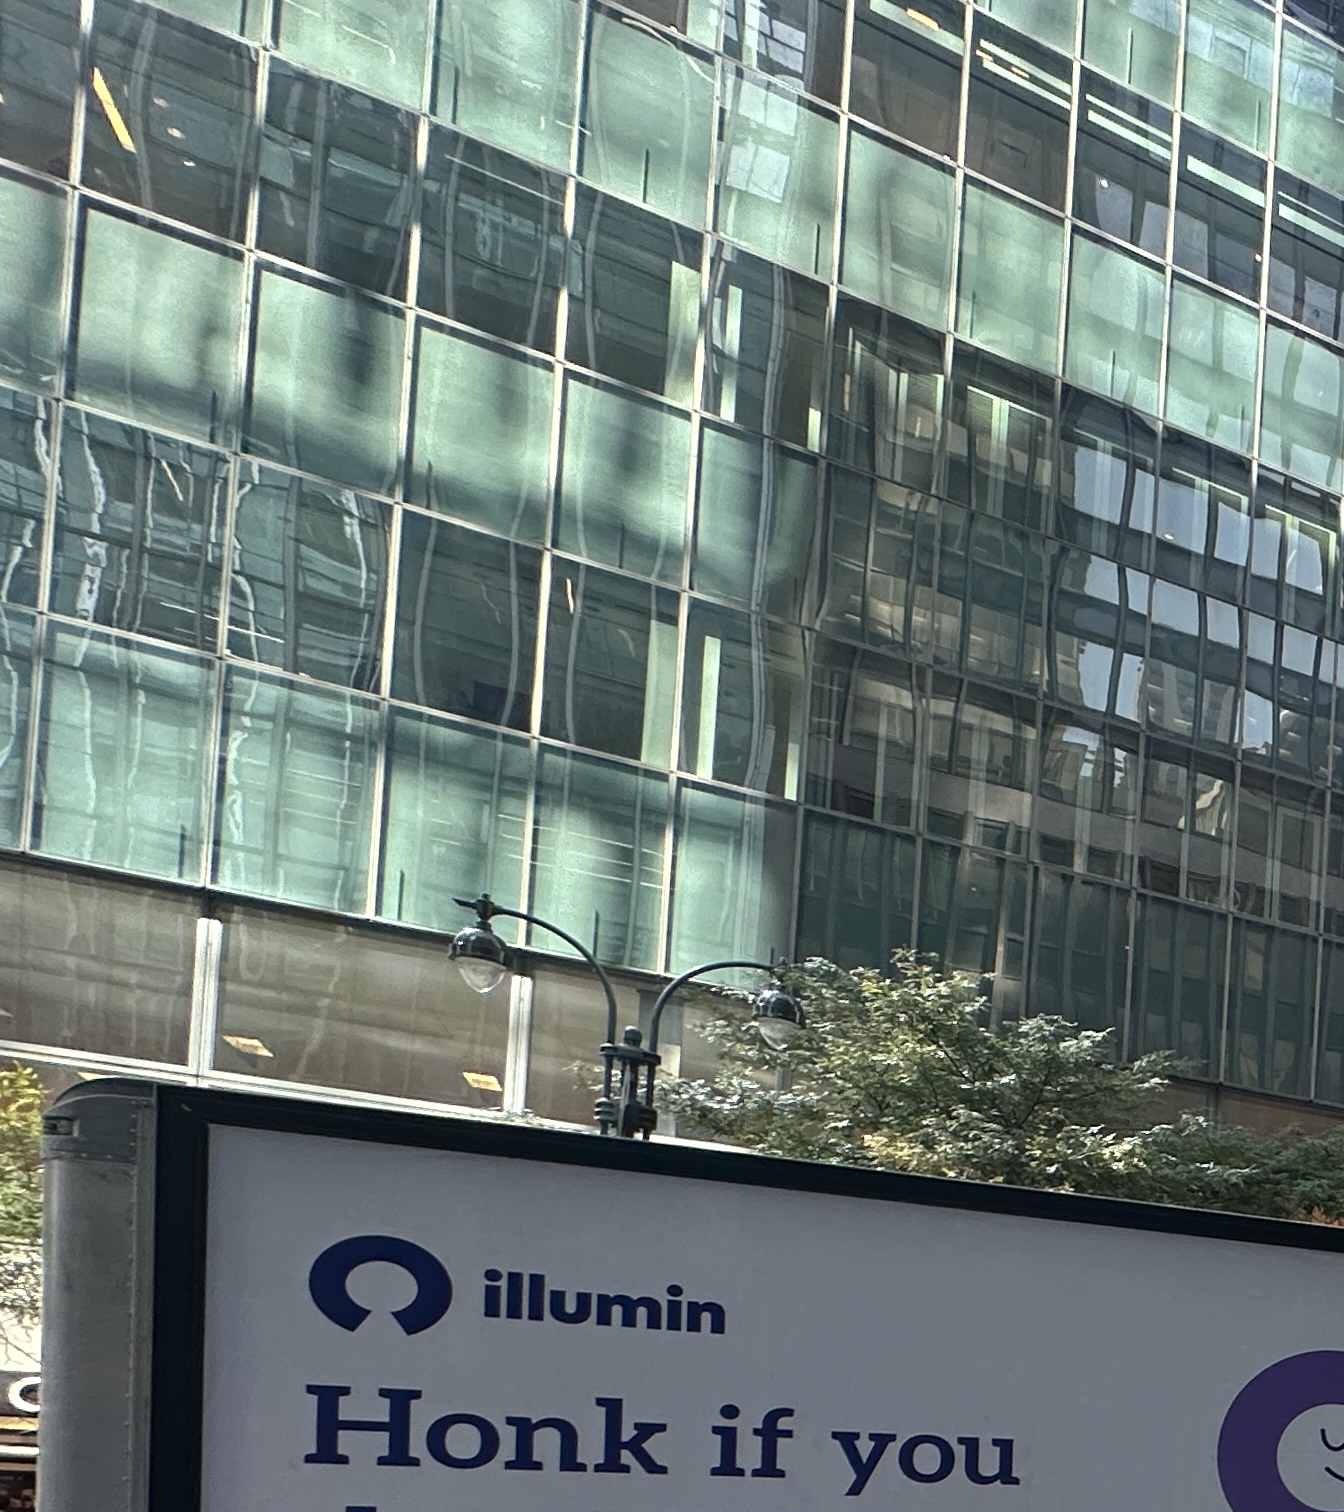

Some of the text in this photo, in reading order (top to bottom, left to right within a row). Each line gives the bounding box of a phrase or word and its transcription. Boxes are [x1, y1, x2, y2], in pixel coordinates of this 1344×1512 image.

[484, 1268, 726, 1335] illumin
[304, 1384, 1020, 1497] Honk if you
